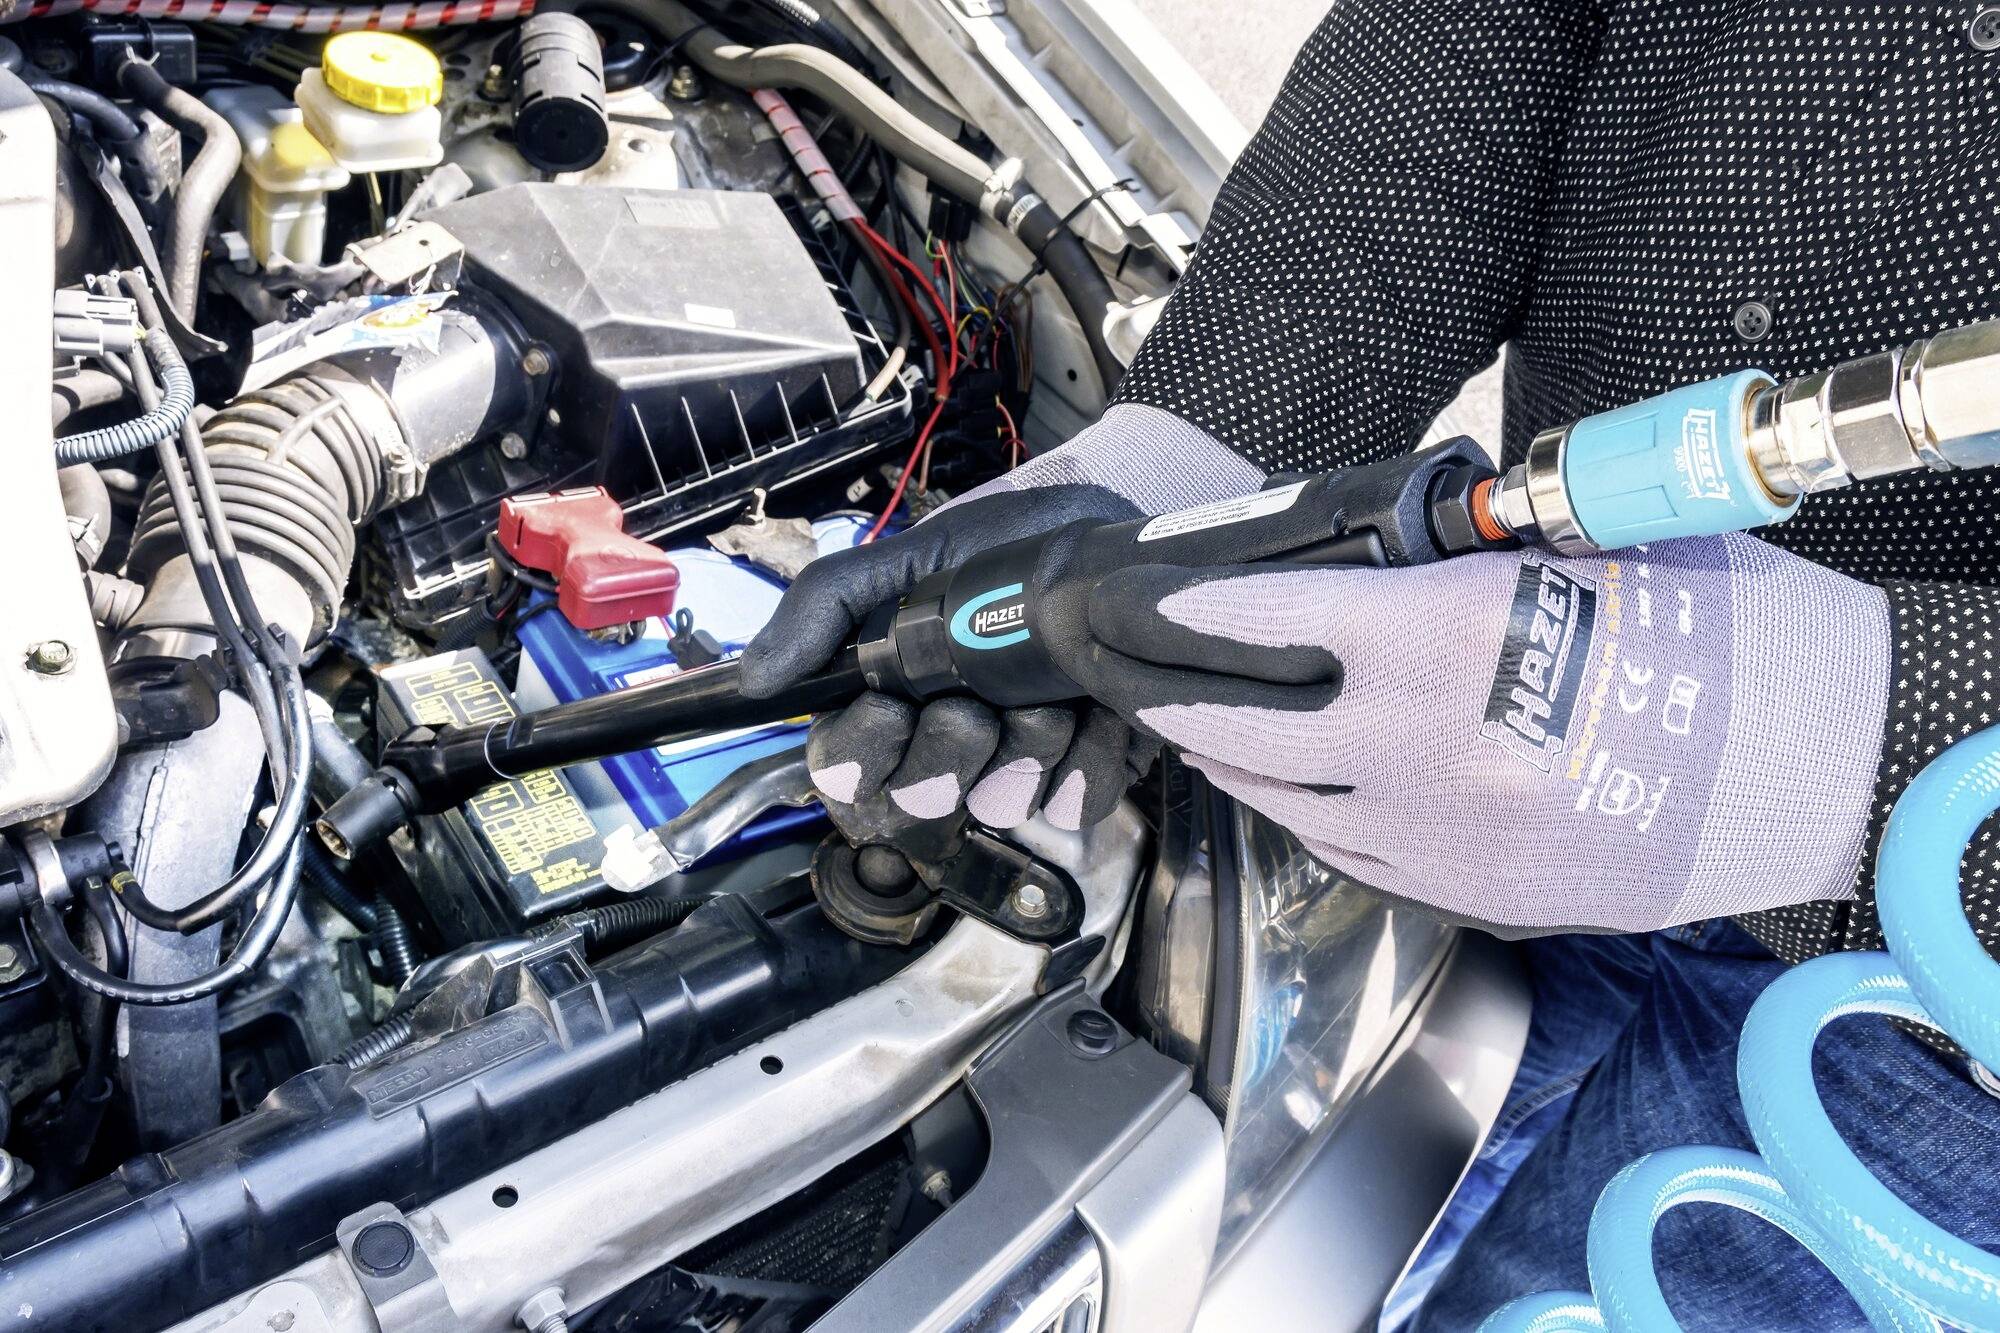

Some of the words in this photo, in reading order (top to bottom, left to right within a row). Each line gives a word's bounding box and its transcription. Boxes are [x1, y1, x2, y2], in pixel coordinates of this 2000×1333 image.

[1688, 415, 1723, 493] HAZET
[974, 603, 1026, 634] HAZET
[1505, 565, 1568, 743] HAZET
